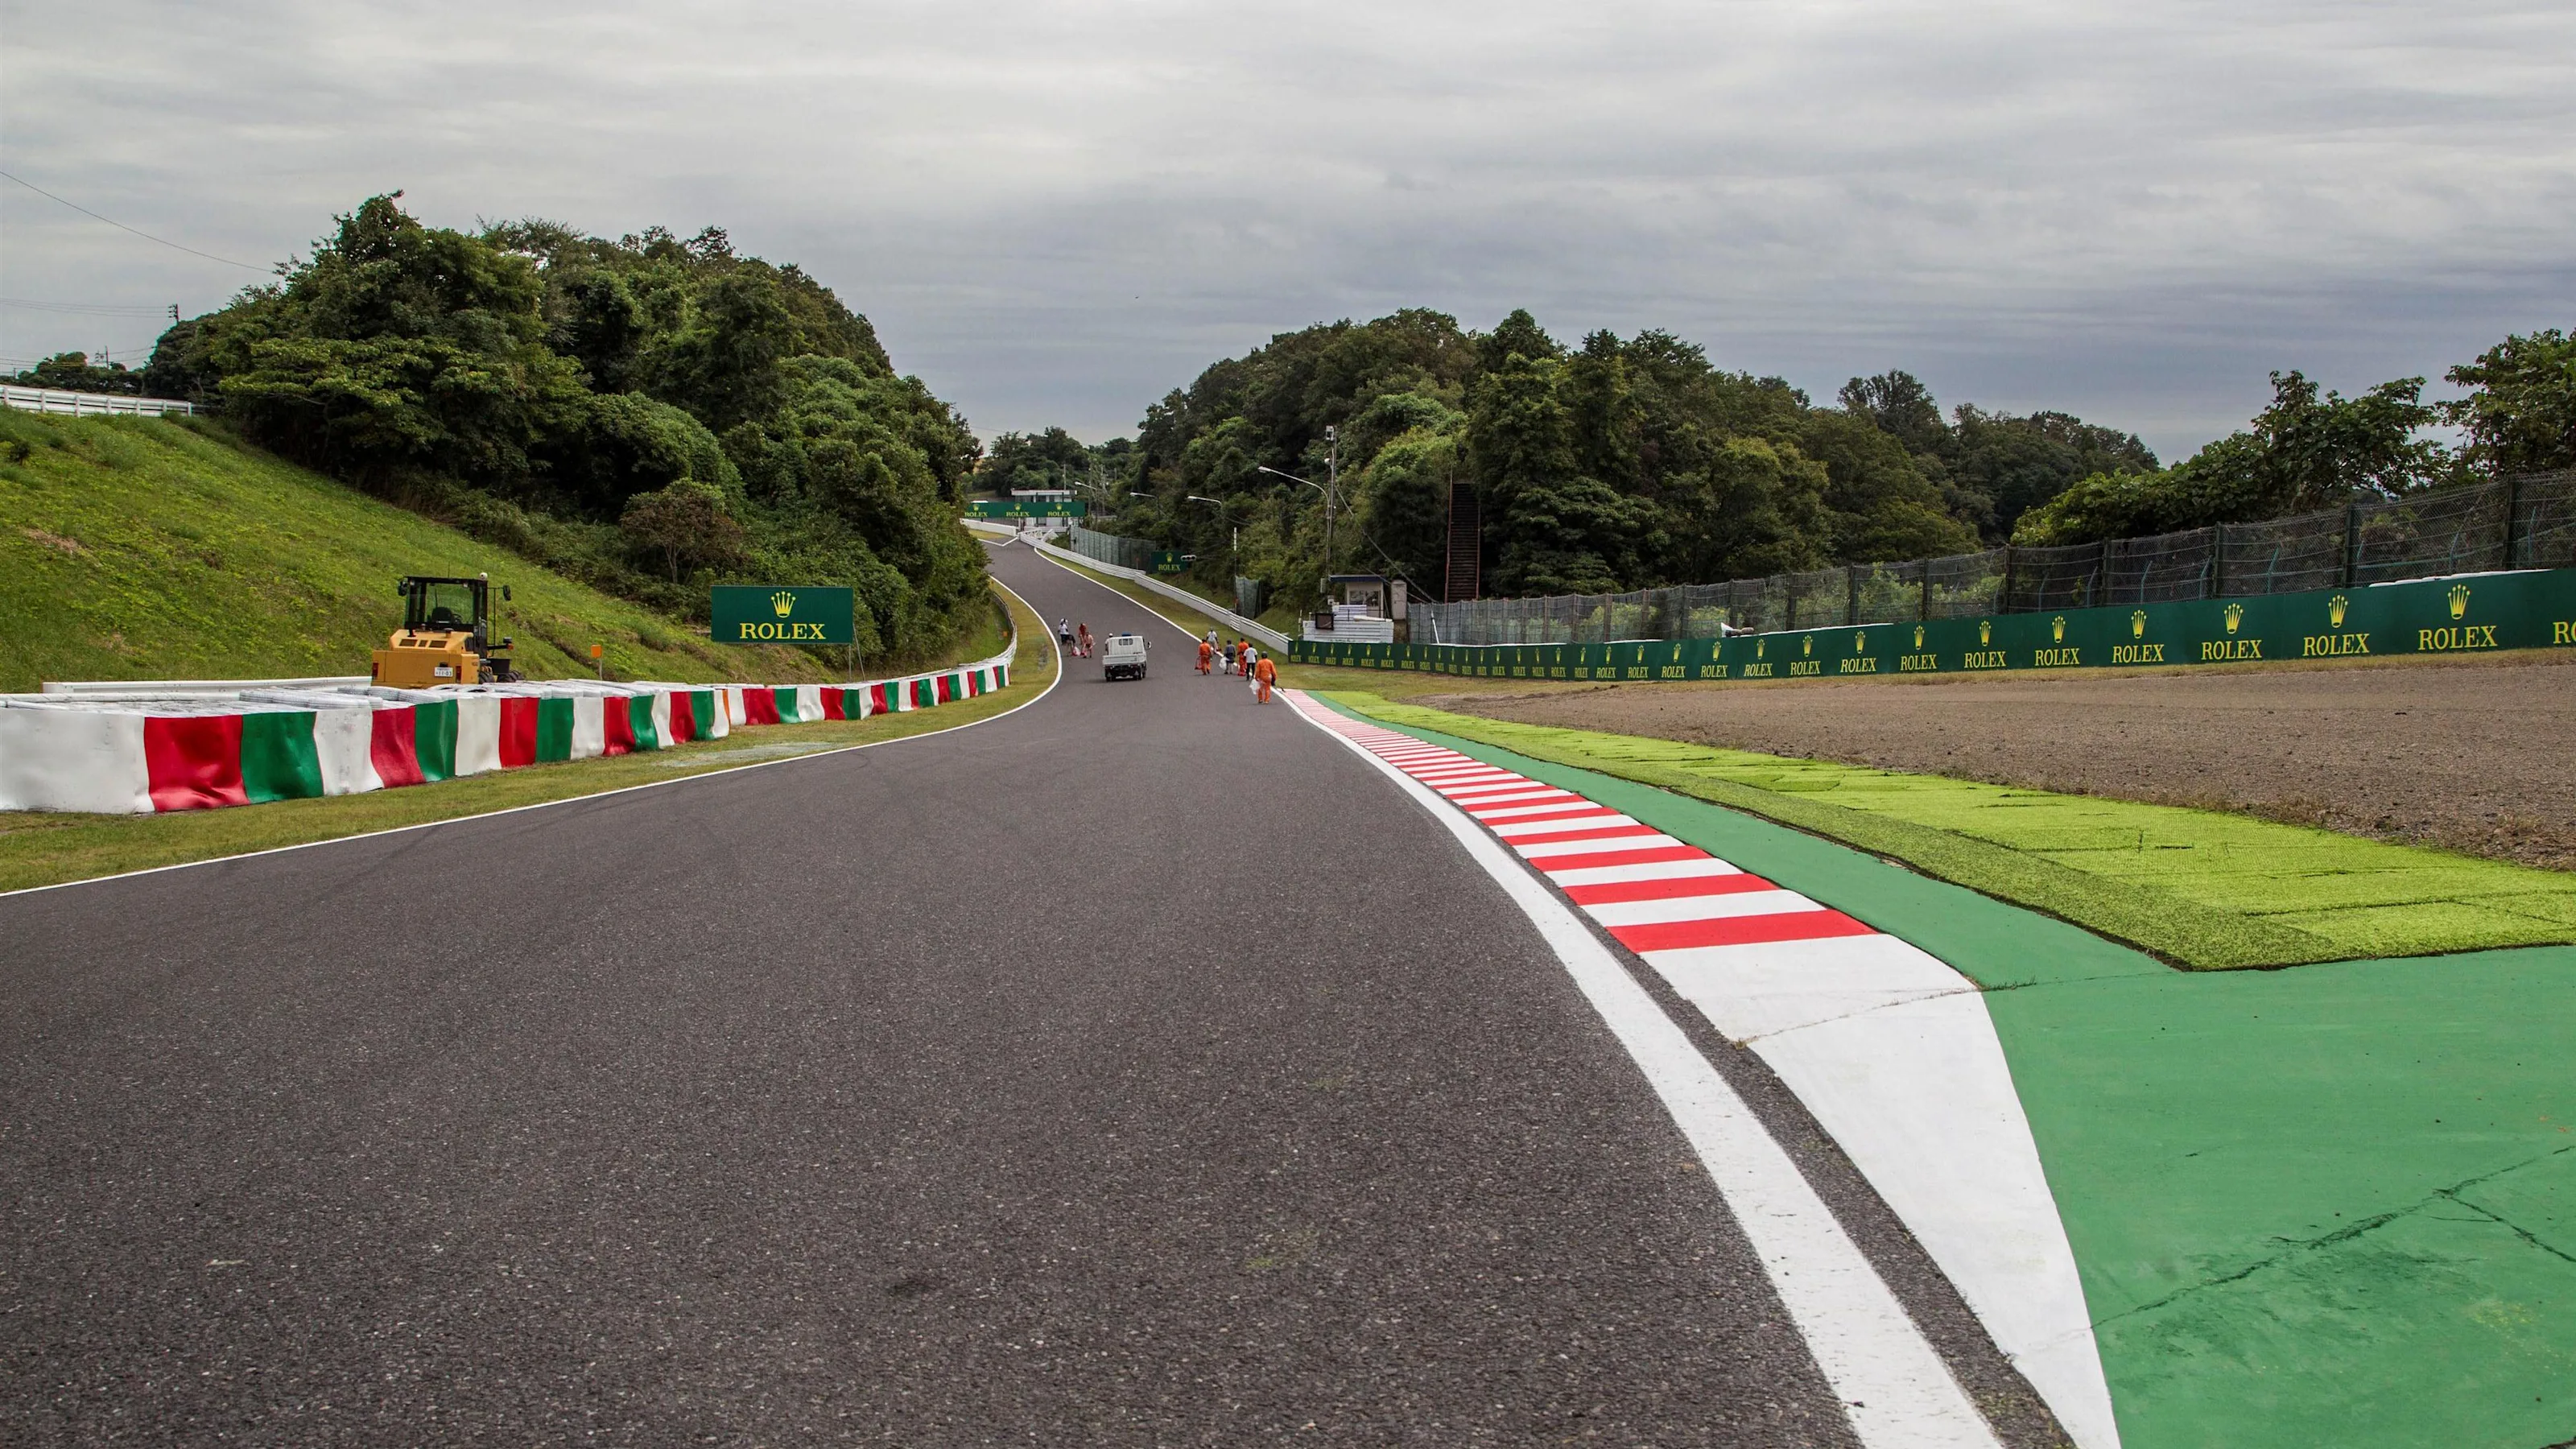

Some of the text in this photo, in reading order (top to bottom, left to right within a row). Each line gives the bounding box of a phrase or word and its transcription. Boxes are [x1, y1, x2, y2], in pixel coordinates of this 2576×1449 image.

[740, 622, 825, 640] ROLEX
[2419, 625, 2499, 651] ROLEX
[2553, 621, 2576, 644] R
[2113, 644, 2164, 663] ROLEX
[2202, 640, 2261, 659] ROLEX
[2304, 634, 2371, 657] ROLEX
[1841, 658, 1876, 672] ROLEX
[1901, 654, 1936, 670] ROLEX
[1965, 651, 2006, 667] ROLEX
[2036, 648, 2079, 666] ROLEX
[1596, 667, 1616, 678] ROLEX
[1628, 667, 1648, 679] ROLEX
[1662, 666, 1685, 679] ROLEX
[1701, 664, 1727, 678] ROLEX
[1744, 663, 1773, 676] ROLEX
[1790, 661, 1820, 676] ROLEX
